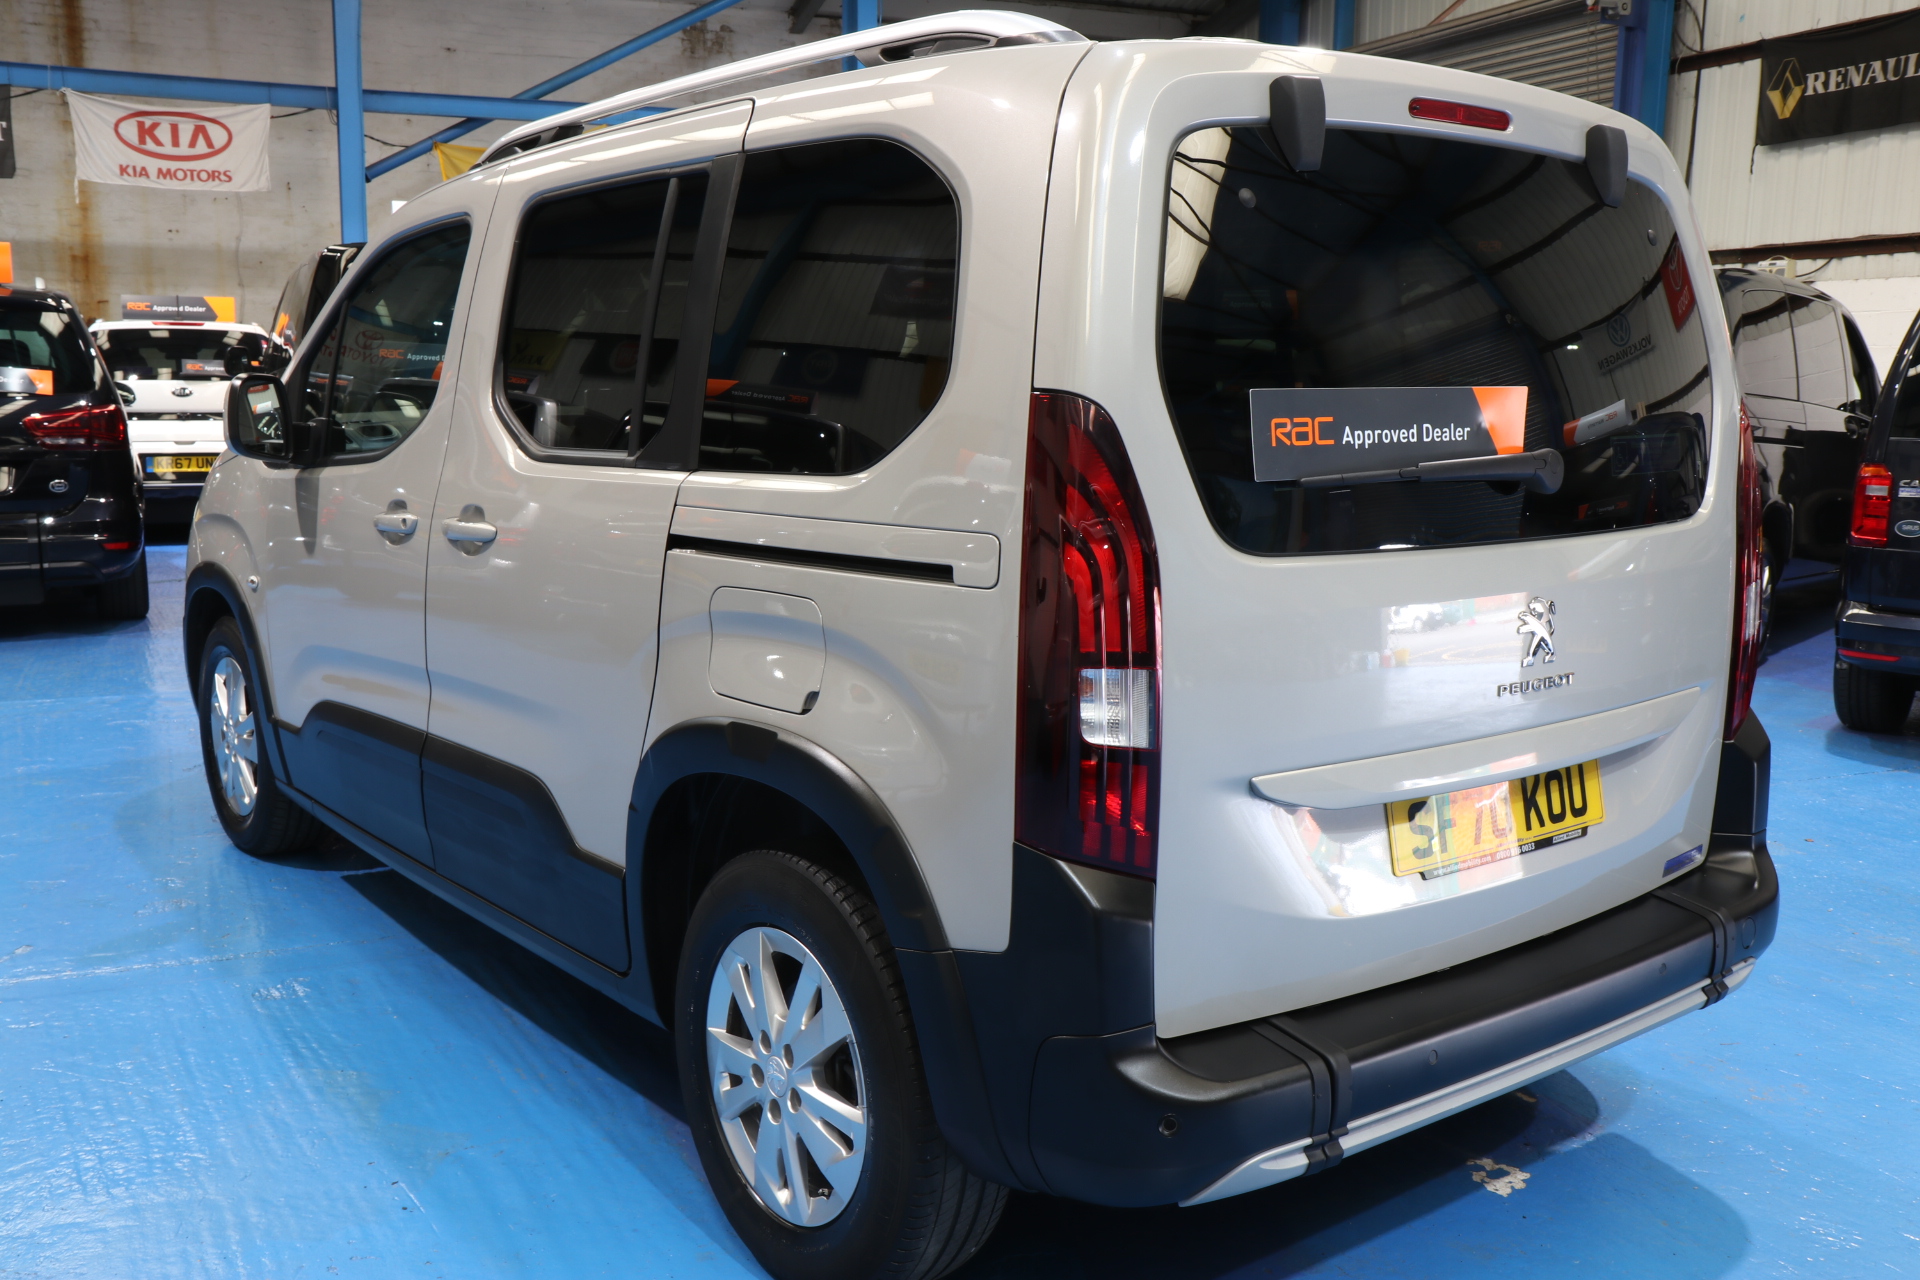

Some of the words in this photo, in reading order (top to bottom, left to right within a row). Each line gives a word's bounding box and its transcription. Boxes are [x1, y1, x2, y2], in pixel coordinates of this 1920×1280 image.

[135, 119, 216, 150] KIA
[118, 163, 151, 179] KIA
[155, 167, 233, 183] MOTORS
[126, 301, 152, 311] RAC
[407, 353, 440, 361] Approved
[1270, 416, 1335, 447] RAC
[1342, 425, 1417, 449] Approved
[1422, 423, 1471, 442] Dealer
[156, 457, 193, 469] KR67
[1496, 672, 1576, 698] PEUGEOT
[1520, 762, 1588, 832] KOU
